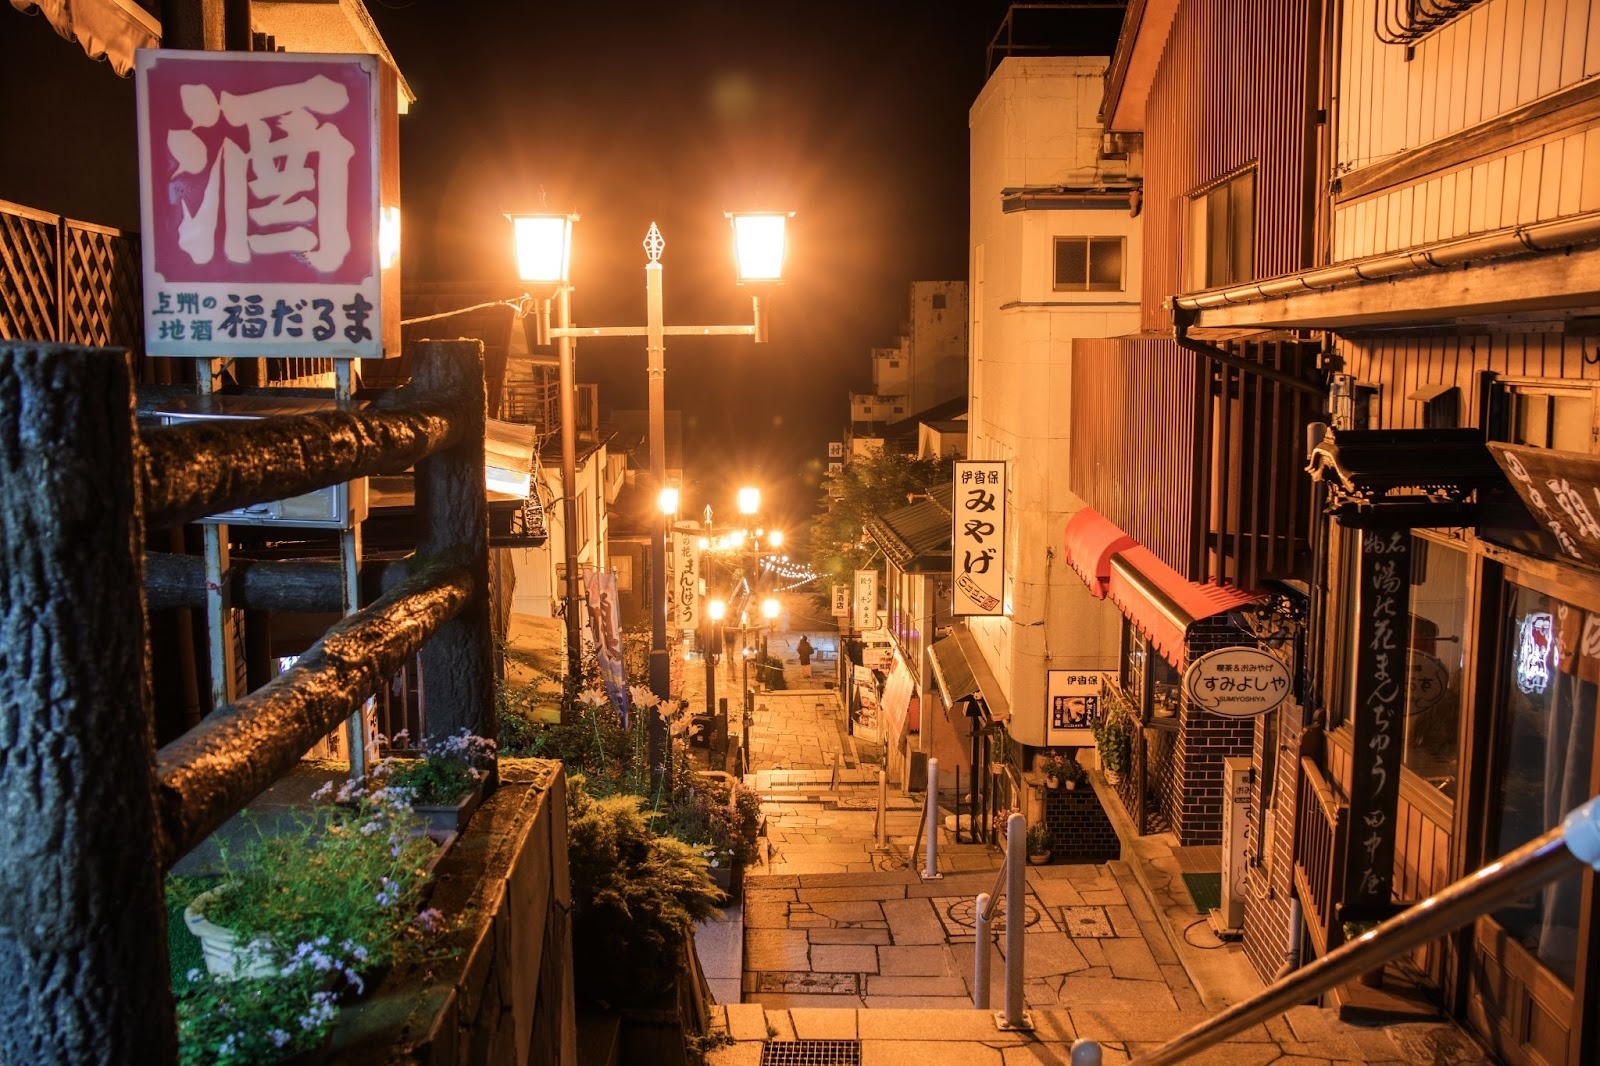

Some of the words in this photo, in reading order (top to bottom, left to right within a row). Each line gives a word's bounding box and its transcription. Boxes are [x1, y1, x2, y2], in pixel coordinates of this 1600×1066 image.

[167, 74, 355, 272] 酒
[152, 292, 217, 315] 上州の
[217, 293, 374, 344] 福だるま
[159, 319, 213, 341] 地酒
[962, 470, 999, 485] 伊香保
[964, 489, 996, 574] みやげ
[1067, 675, 1098, 685] 伊香保
[1203, 676, 1286, 692] すみよしや
